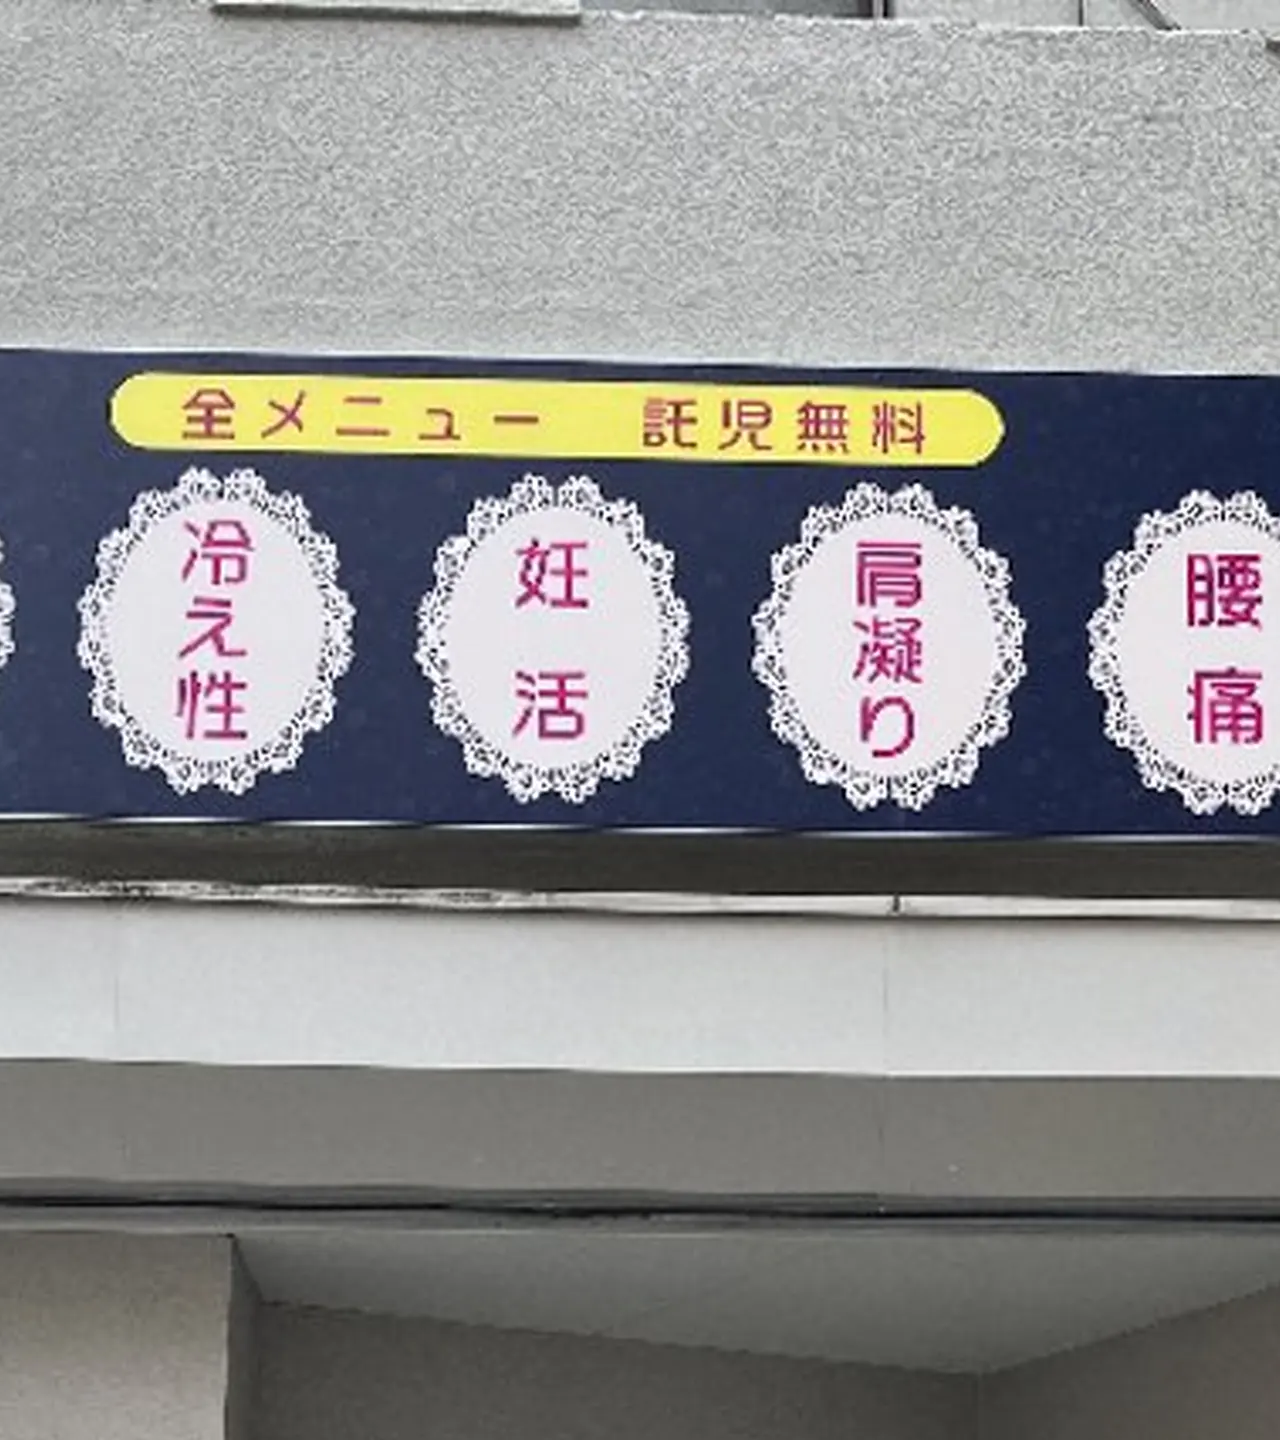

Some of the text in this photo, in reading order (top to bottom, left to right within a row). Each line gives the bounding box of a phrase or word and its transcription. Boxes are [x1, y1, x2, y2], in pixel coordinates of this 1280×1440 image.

[181, 388, 926, 456] 全メニュー 託児無料
[175, 519, 254, 742] 冷え性
[513, 538, 590, 741] 妊活
[851, 540, 923, 760] 肩凝り
[1185, 553, 1265, 746] 腰痛
